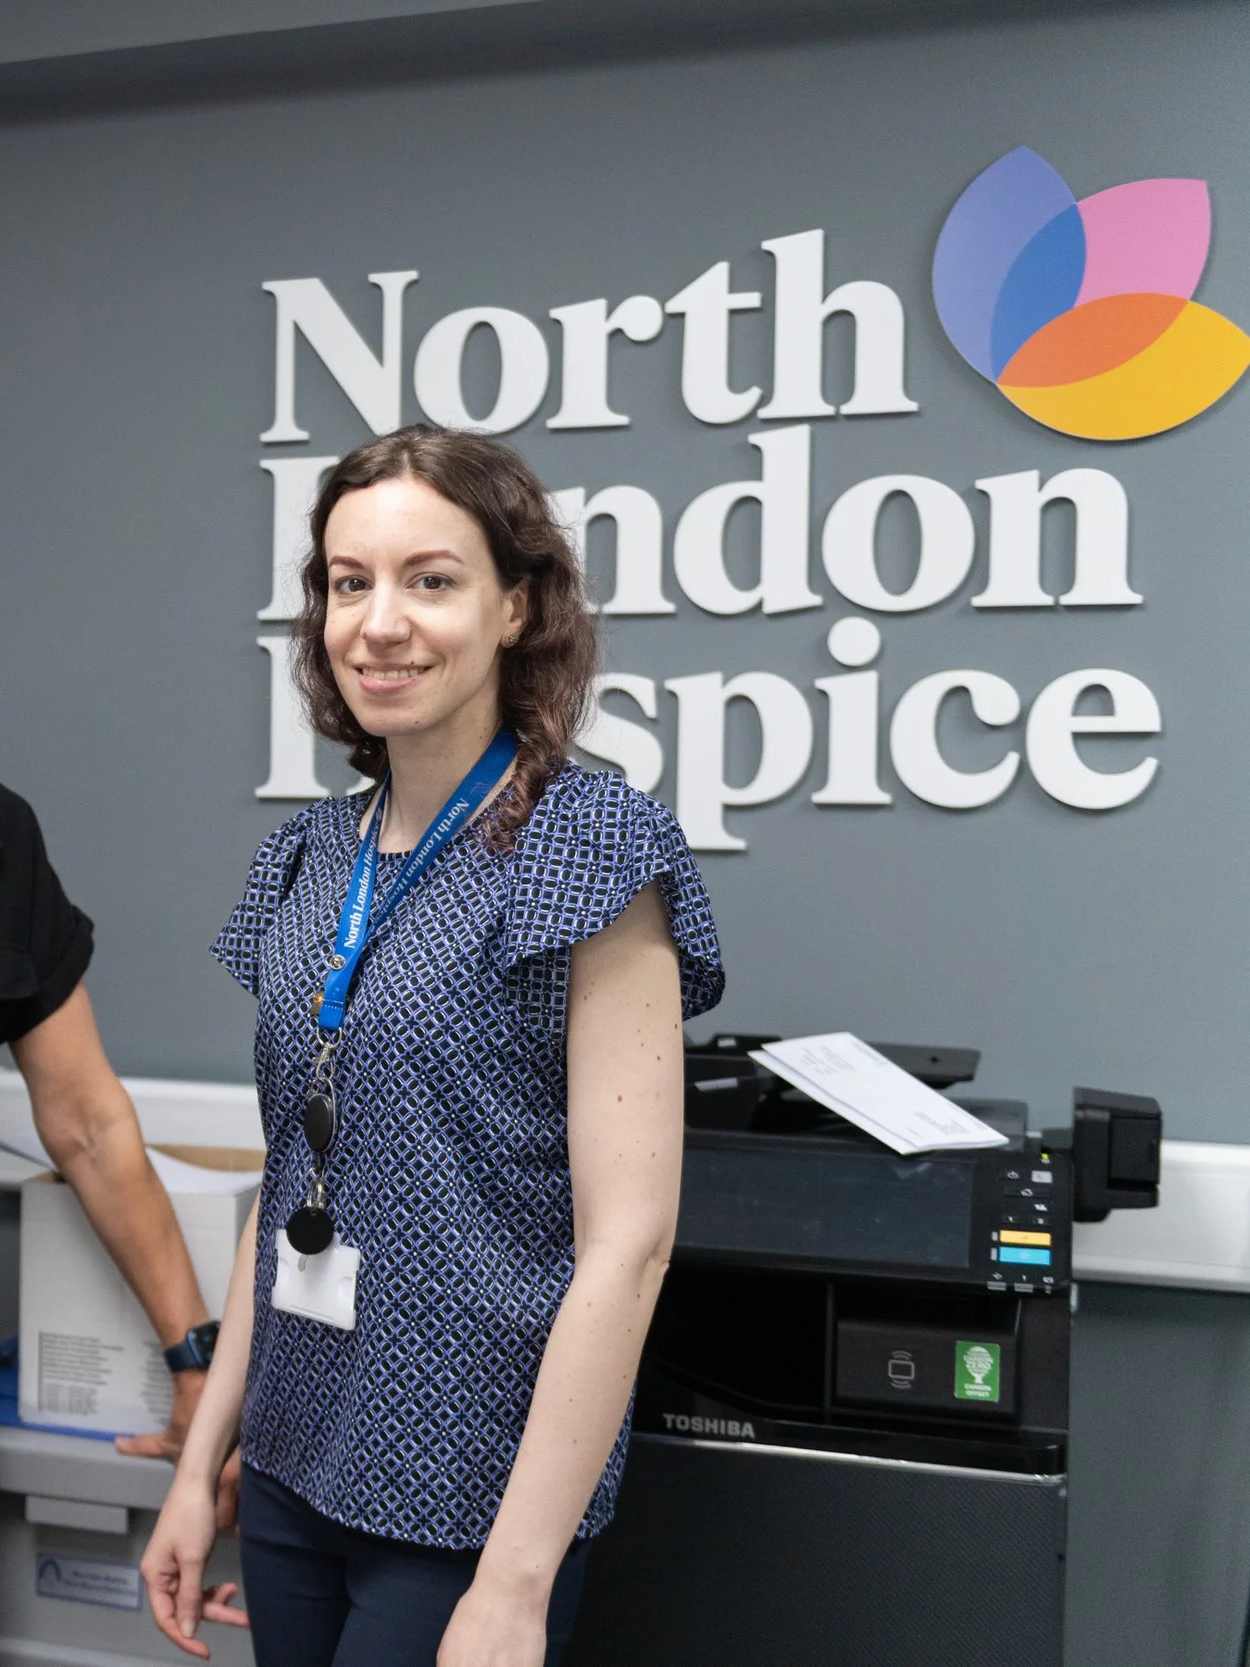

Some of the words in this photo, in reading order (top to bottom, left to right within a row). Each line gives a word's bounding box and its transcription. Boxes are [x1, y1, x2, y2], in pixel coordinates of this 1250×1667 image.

[261, 229, 918, 443] North
[437, 797, 469, 833] North
[405, 831, 442, 877] London
[352, 866, 371, 912] London
[344, 911, 363, 948] North
[662, 1413, 755, 1439] TOSHIBA
